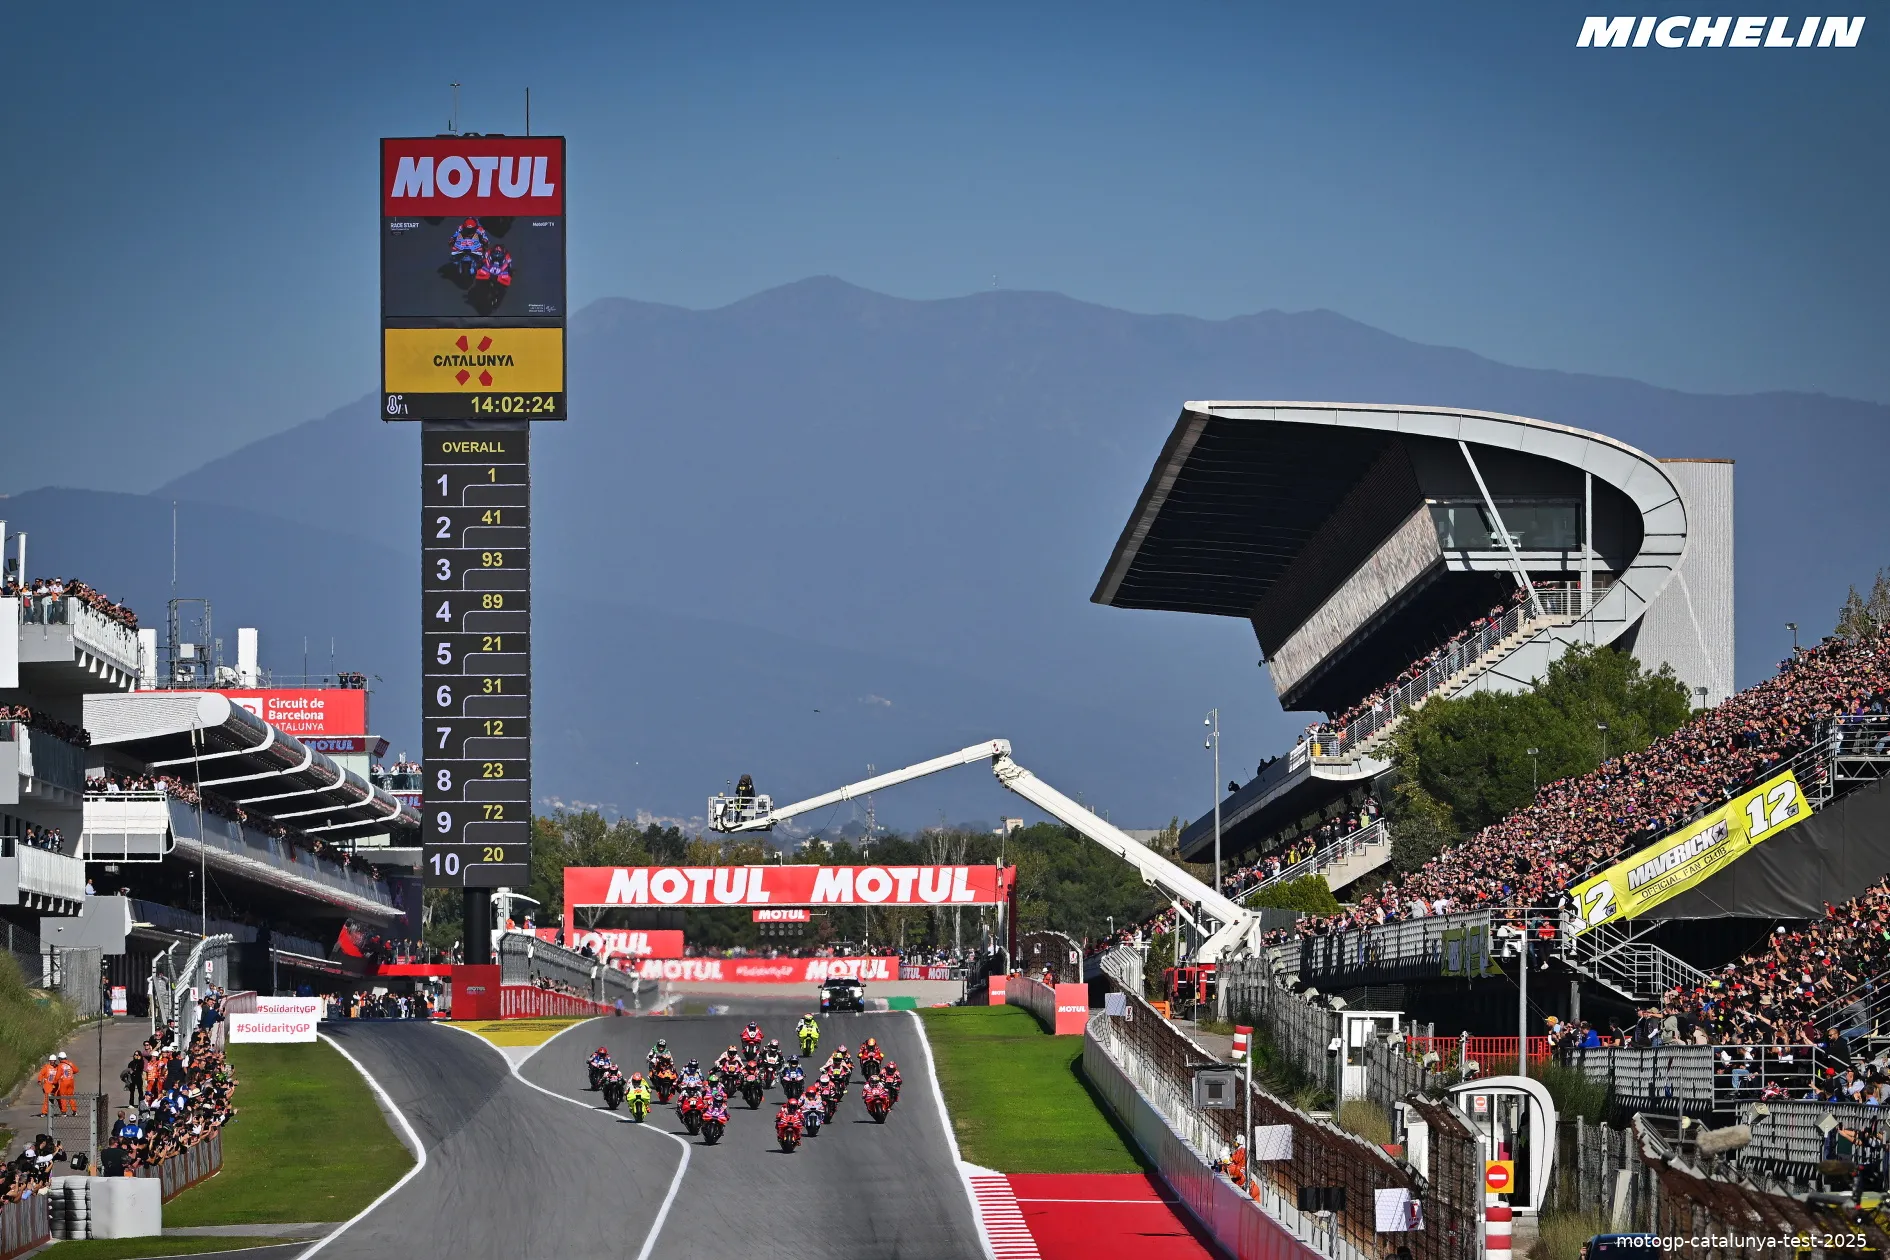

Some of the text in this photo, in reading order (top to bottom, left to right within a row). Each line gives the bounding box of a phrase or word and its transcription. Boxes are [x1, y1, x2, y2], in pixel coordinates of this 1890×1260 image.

[391, 156, 554, 198] MOTUL
[433, 355, 514, 367] CATALUNYA
[471, 396, 555, 413] 14:02:24
[442, 442, 505, 453] OVERALL
[488, 468, 496, 482] 1
[437, 474, 448, 496] 1
[482, 510, 501, 524] 41
[436, 516, 450, 538] 2
[482, 552, 503, 566] 93
[436, 558, 451, 580] 3
[482, 594, 503, 608] 89
[436, 601, 451, 622] 4
[482, 636, 502, 650] 21
[436, 643, 452, 665] 5
[482, 678, 502, 694] 31
[268, 698, 324, 708] Circuit de
[436, 685, 452, 707] 6
[268, 710, 324, 720] Barcelona
[271, 722, 324, 731] ATALUNYA
[483, 721, 504, 736] 12
[436, 727, 452, 748] 7
[482, 763, 504, 778] 23
[436, 770, 452, 791] 8
[482, 805, 504, 820] 72
[1746, 780, 1798, 838] 12
[436, 812, 452, 834] 9
[482, 847, 504, 862] 20
[1627, 826, 1716, 891] MAVERICK
[430, 854, 459, 876] 10
[1642, 846, 1727, 899] OFFICIAL FAN CLUB
[605, 868, 770, 903] MOTUL
[810, 868, 976, 903] MOTUL
[758, 910, 804, 920] MOTUL
[640, 960, 723, 981] MOTUL
[805, 959, 889, 980] MOTUL
[256, 1004, 316, 1014] #SolidarityGP
[237, 1023, 310, 1034] #SolidarityGP
